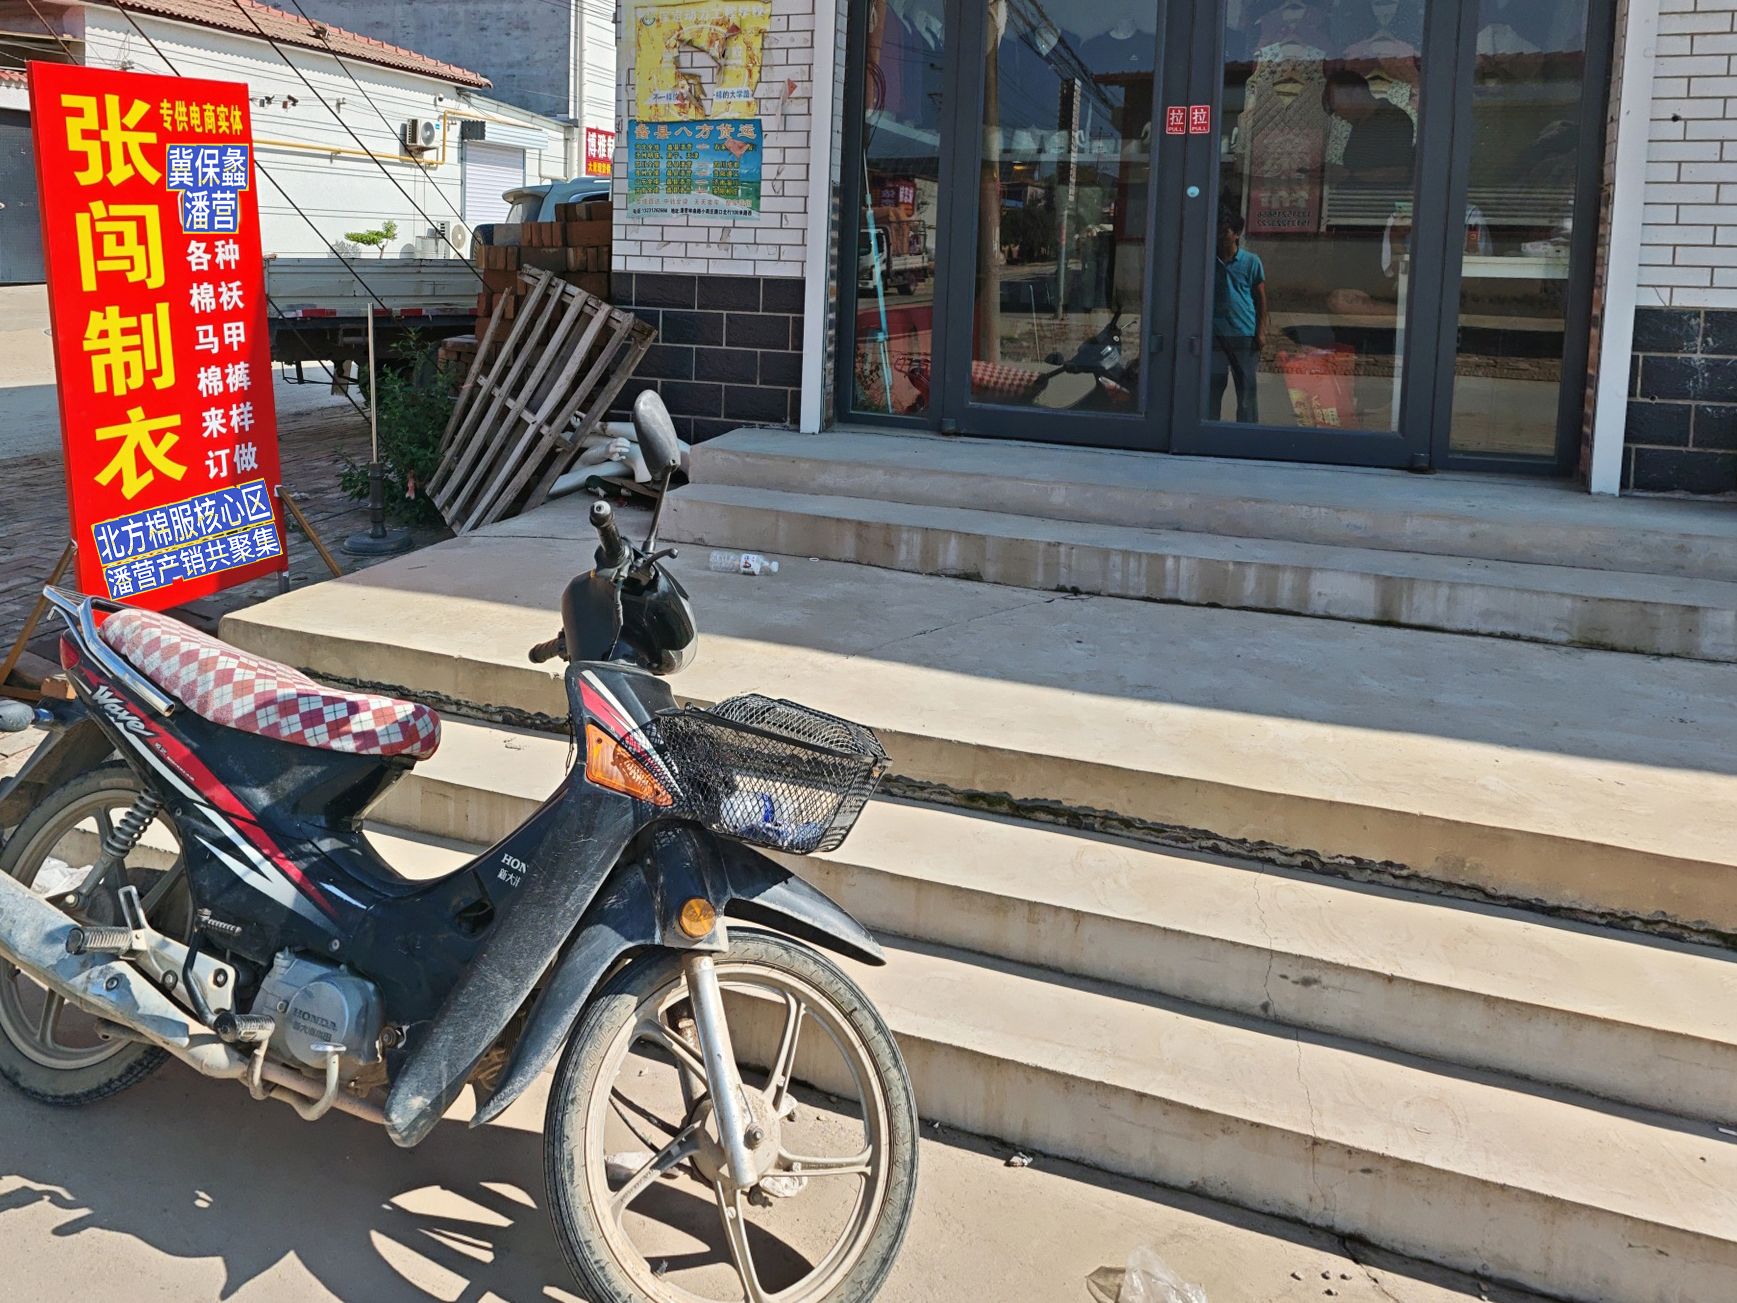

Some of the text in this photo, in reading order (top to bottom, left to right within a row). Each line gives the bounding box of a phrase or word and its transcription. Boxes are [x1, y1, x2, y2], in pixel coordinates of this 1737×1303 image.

[160, 99, 243, 135] 专供电商实体
[1170, 109, 1184, 125] 拉
[1193, 108, 1207, 125] 拉
[169, 147, 246, 187] 冀保蠡
[184, 190, 236, 230] 潘营
[186, 239, 240, 272] 各种
[60, 93, 188, 500] 张闯制衣
[195, 321, 246, 354] 马甲
[197, 361, 252, 398] 棉裤
[202, 402, 255, 439] 来样
[205, 442, 259, 480] 订做
[97, 484, 271, 561] 北方棉服核心区
[108, 526, 281, 597] 潘营产销共聚集
[92, 684, 156, 737] Wave
[294, 1007, 338, 1032] HONDA
